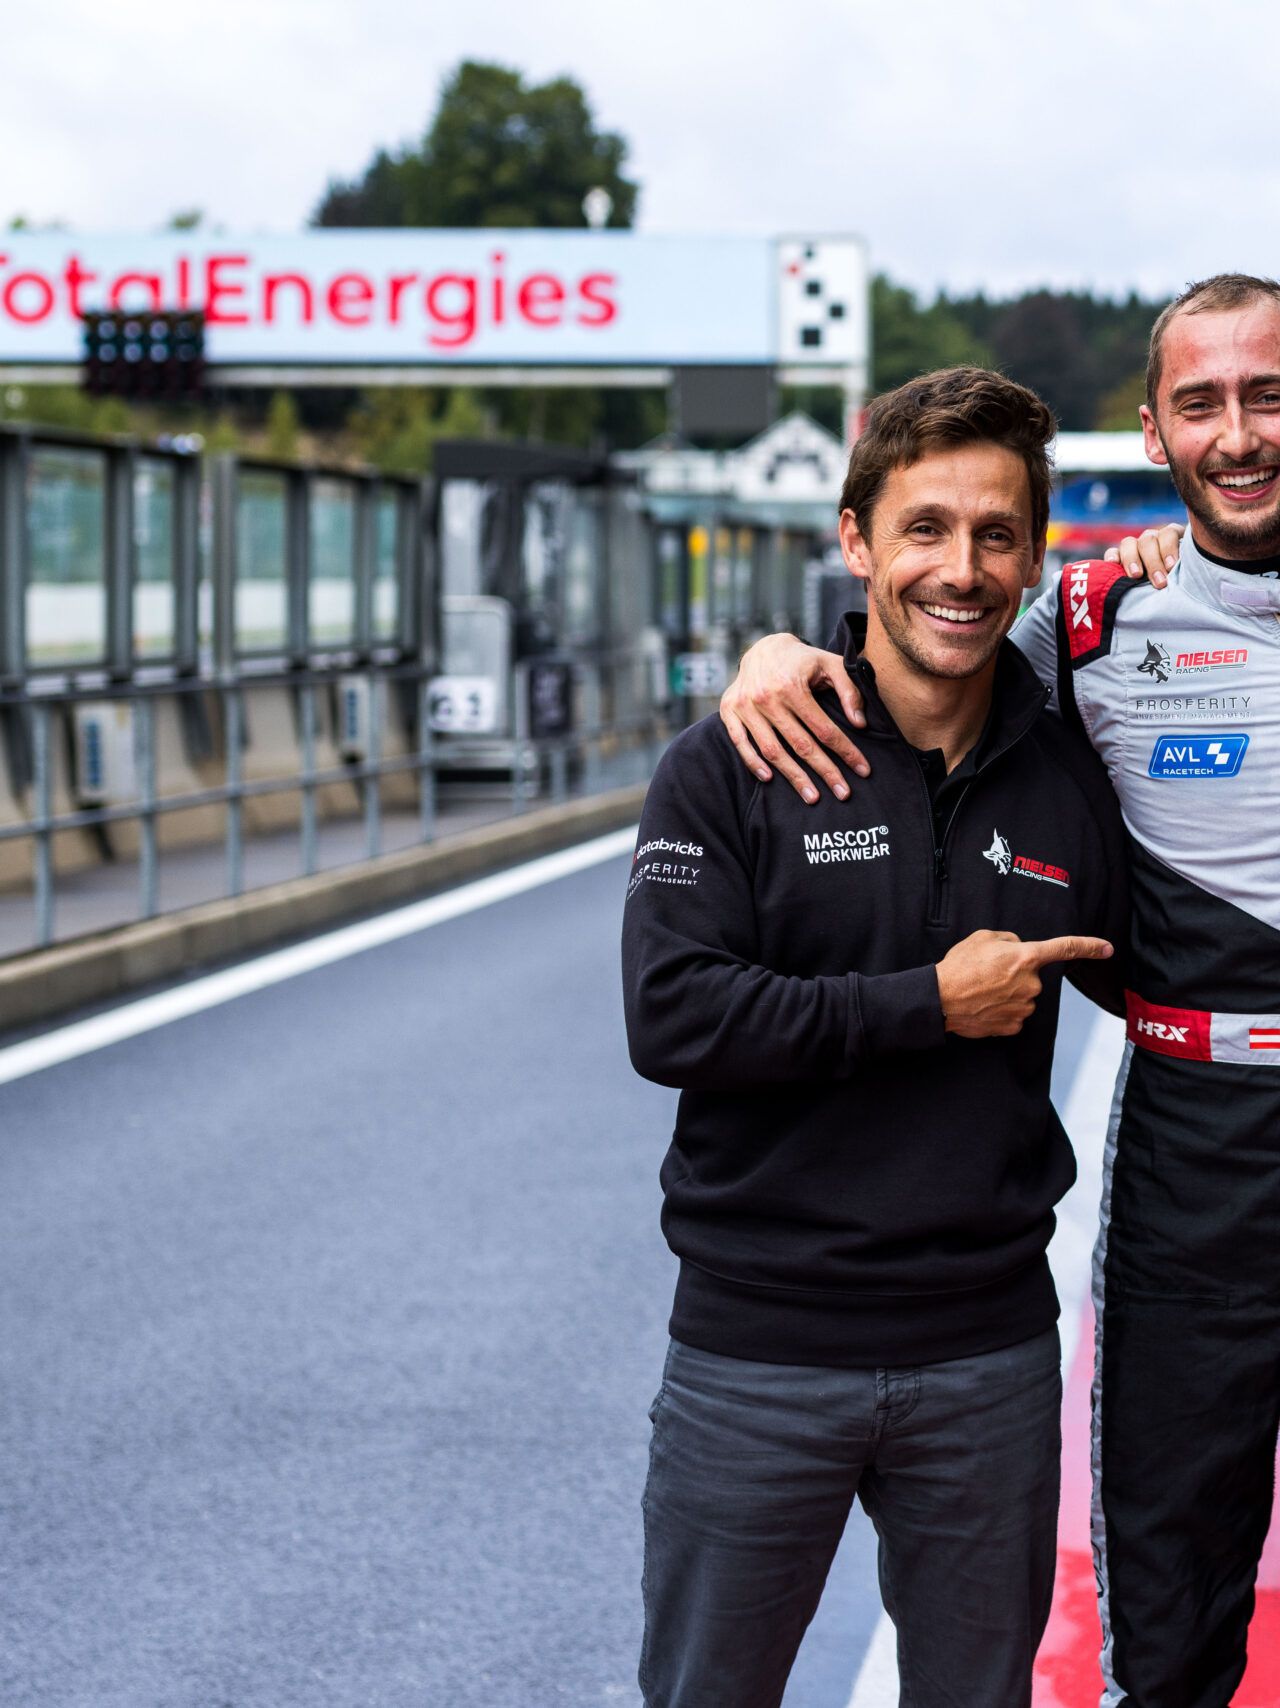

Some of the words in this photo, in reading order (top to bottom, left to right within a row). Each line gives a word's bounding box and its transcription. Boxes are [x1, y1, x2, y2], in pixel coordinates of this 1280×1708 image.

[1070, 562, 1093, 631] HRX
[1176, 649, 1248, 668] NIELSEN
[1176, 667, 1210, 675] RACING
[1163, 746, 1201, 763] AVL
[637, 837, 704, 859] databricks
[806, 843, 890, 864] WORKWEAR
[1012, 867, 1043, 881] RACING
[1013, 855, 1070, 884] NIELSEN
[646, 875, 699, 886] MANAGEMENT
[1137, 1018, 1190, 1043] HRX
